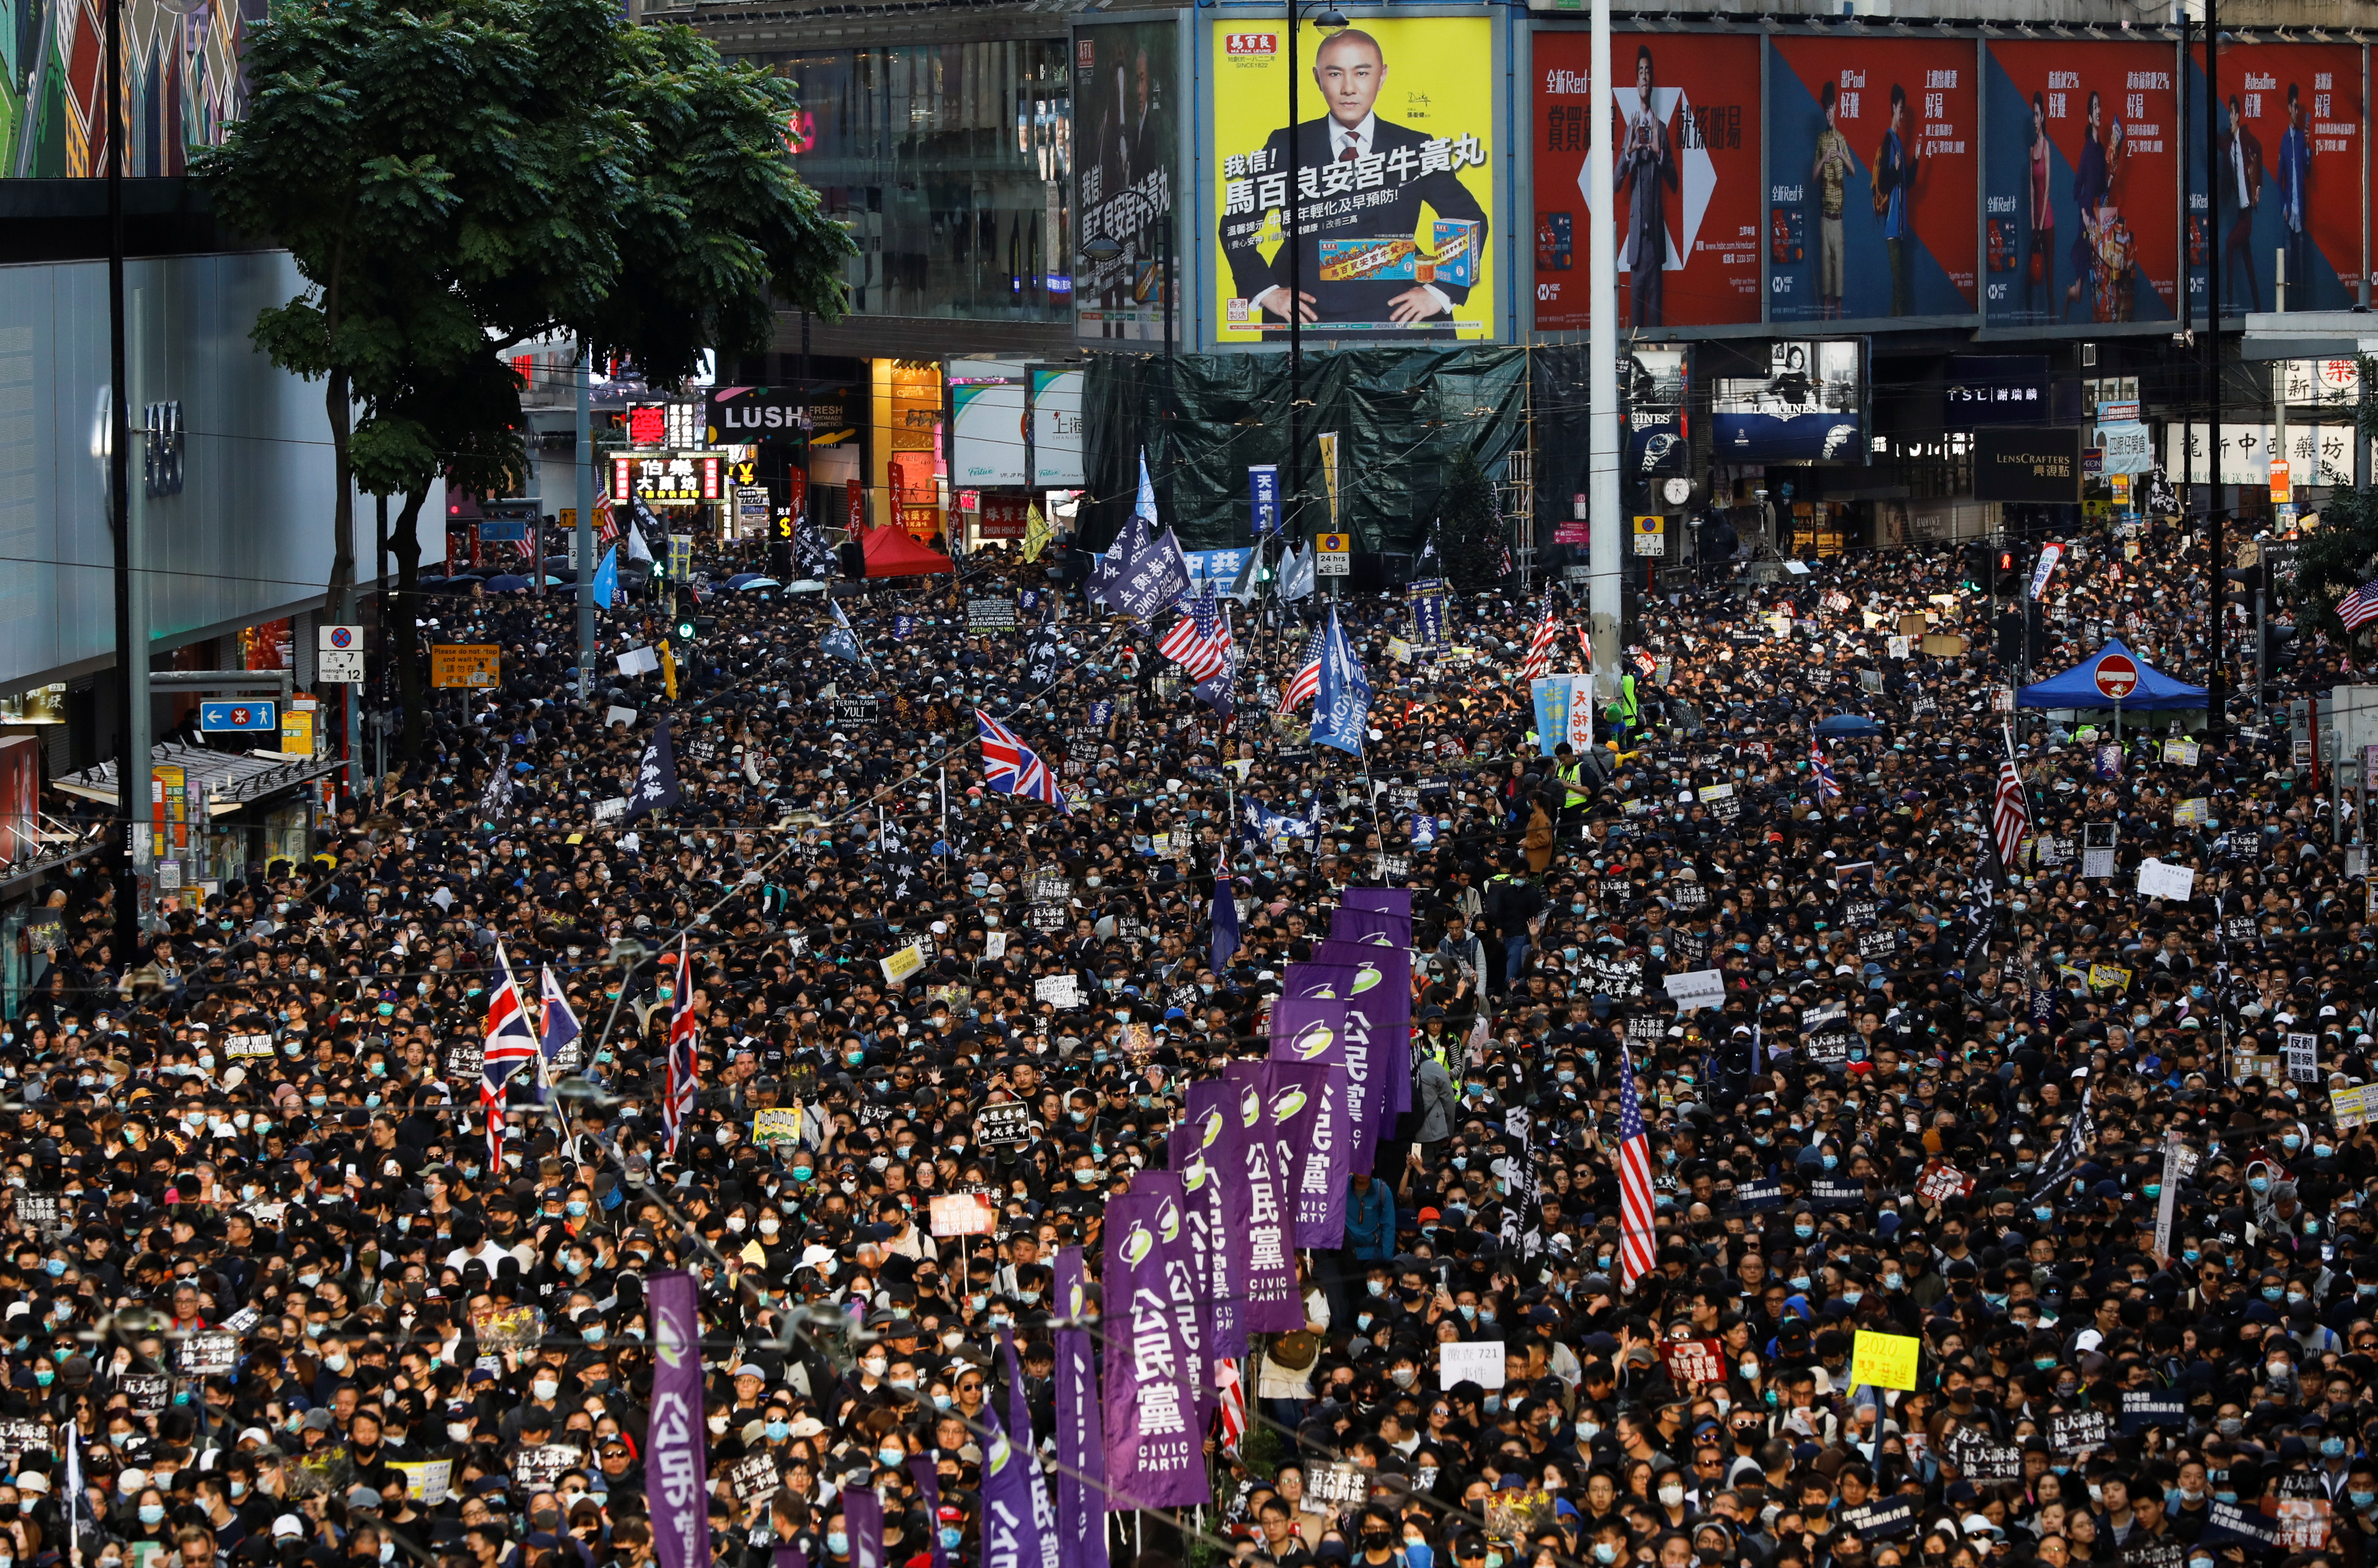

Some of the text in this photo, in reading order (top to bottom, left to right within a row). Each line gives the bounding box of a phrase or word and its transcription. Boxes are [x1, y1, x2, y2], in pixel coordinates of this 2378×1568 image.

[1230, 35, 1271, 49] 馬百良
[1546, 69, 1591, 94] 全新Red
[1841, 92, 1859, 118] 好難
[1925, 93, 1943, 118] 好易
[2049, 93, 2066, 118] 好難
[2127, 94, 2143, 119] 好易
[2245, 94, 2261, 118] 好難
[2315, 94, 2330, 118] 好易
[1224, 148, 1277, 179] 我信!
[1225, 132, 1486, 217] 馬百良安宮牛黃丸
[809, 406, 843, 415] FRESH
[1753, 403, 1818, 414] LONGINES
[725, 406, 803, 429] LUSH
[631, 407, 665, 446] 藥
[640, 459, 694, 476] 伯樂
[2033, 465, 2069, 477] 亮視點
[637, 476, 697, 491] 大藥坊
[347, 653, 354, 662] 7
[347, 670, 360, 680] 12
[844, 707, 864, 718] YULI
[2231, 836, 2258, 845] 五大訴求
[1037, 880, 1071, 891] 五大訴求
[1674, 887, 1705, 896] 五大訴求
[1033, 908, 1065, 918] 五大訴求
[1033, 916, 1065, 927] 缺一不可
[1578, 977, 1644, 996] 時代革命
[1629, 1018, 1664, 1028] 五大訴求
[1629, 1028, 1664, 1037] 堅持到底
[225, 1034, 272, 1048] STAND WITH
[1808, 1034, 1846, 1048] 五大訴求
[2291, 1036, 2313, 1049] 反對
[227, 1042, 273, 1057] HONG KONG
[1808, 1045, 1846, 1058] 缺一不可
[2291, 1052, 2314, 1066] 警察
[2291, 1068, 2314, 1081] 濫暴
[980, 1124, 1028, 1140] 時代革命
[1246, 1142, 1285, 1271] 公民黨
[1249, 1276, 1287, 1290] CIVIC
[1249, 1288, 1287, 1302] PARTY
[181, 1336, 235, 1352] 五大訴求
[1858, 1336, 1898, 1356] 2020
[181, 1351, 235, 1365] 缺一不可
[1479, 1348, 1498, 1359] 721
[1131, 1288, 1186, 1436] 公民黨
[1459, 1365, 1487, 1381] 事件
[2054, 1412, 2105, 1431] 五大訴求
[2055, 1427, 2105, 1447] 缺一不可
[1138, 1441, 1189, 1457] CIVIC
[1963, 1446, 2020, 1465] 五大訴求
[1138, 1453, 1189, 1472] PARTY
[1963, 1460, 2021, 1478] 缺一不可
[1311, 1469, 1366, 1489] 五大訴求
